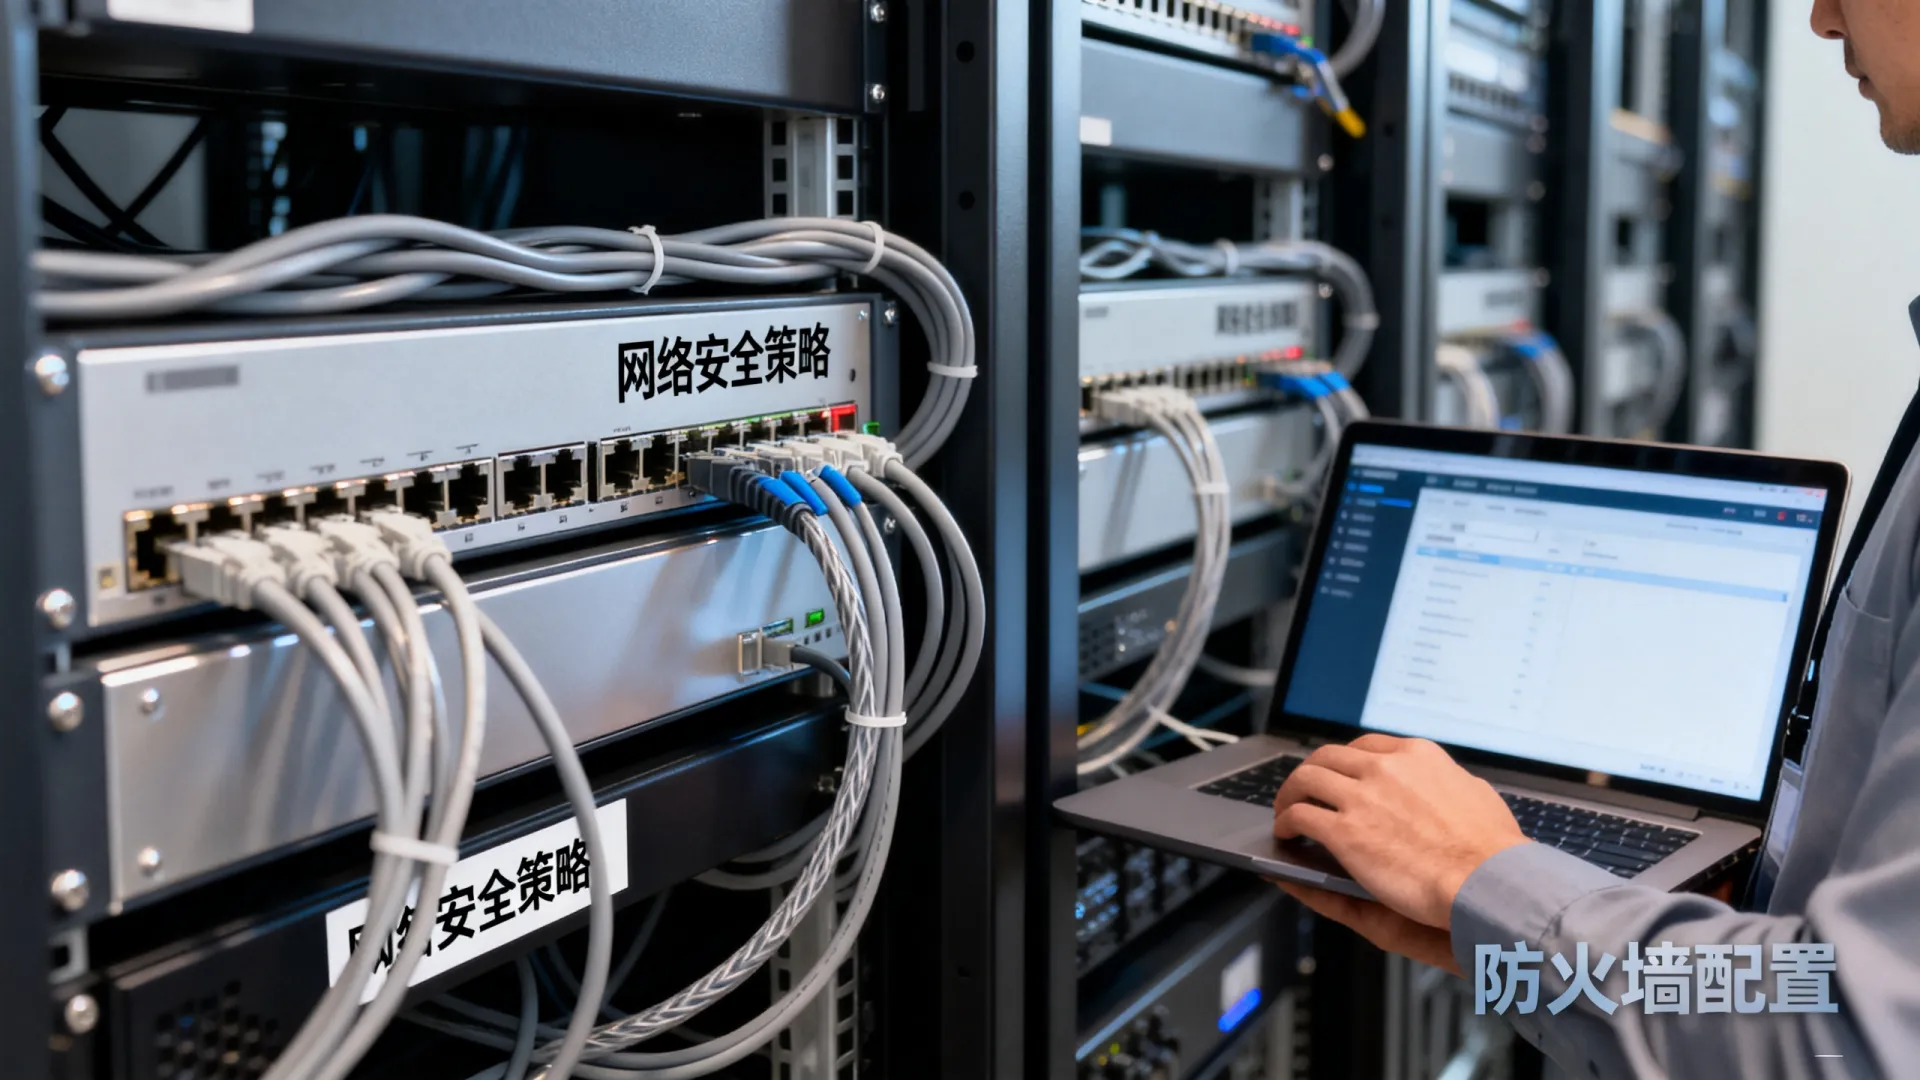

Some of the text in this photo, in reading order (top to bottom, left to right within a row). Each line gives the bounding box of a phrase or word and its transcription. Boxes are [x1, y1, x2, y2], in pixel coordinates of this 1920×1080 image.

[618, 322, 831, 403] 网络安全策略
